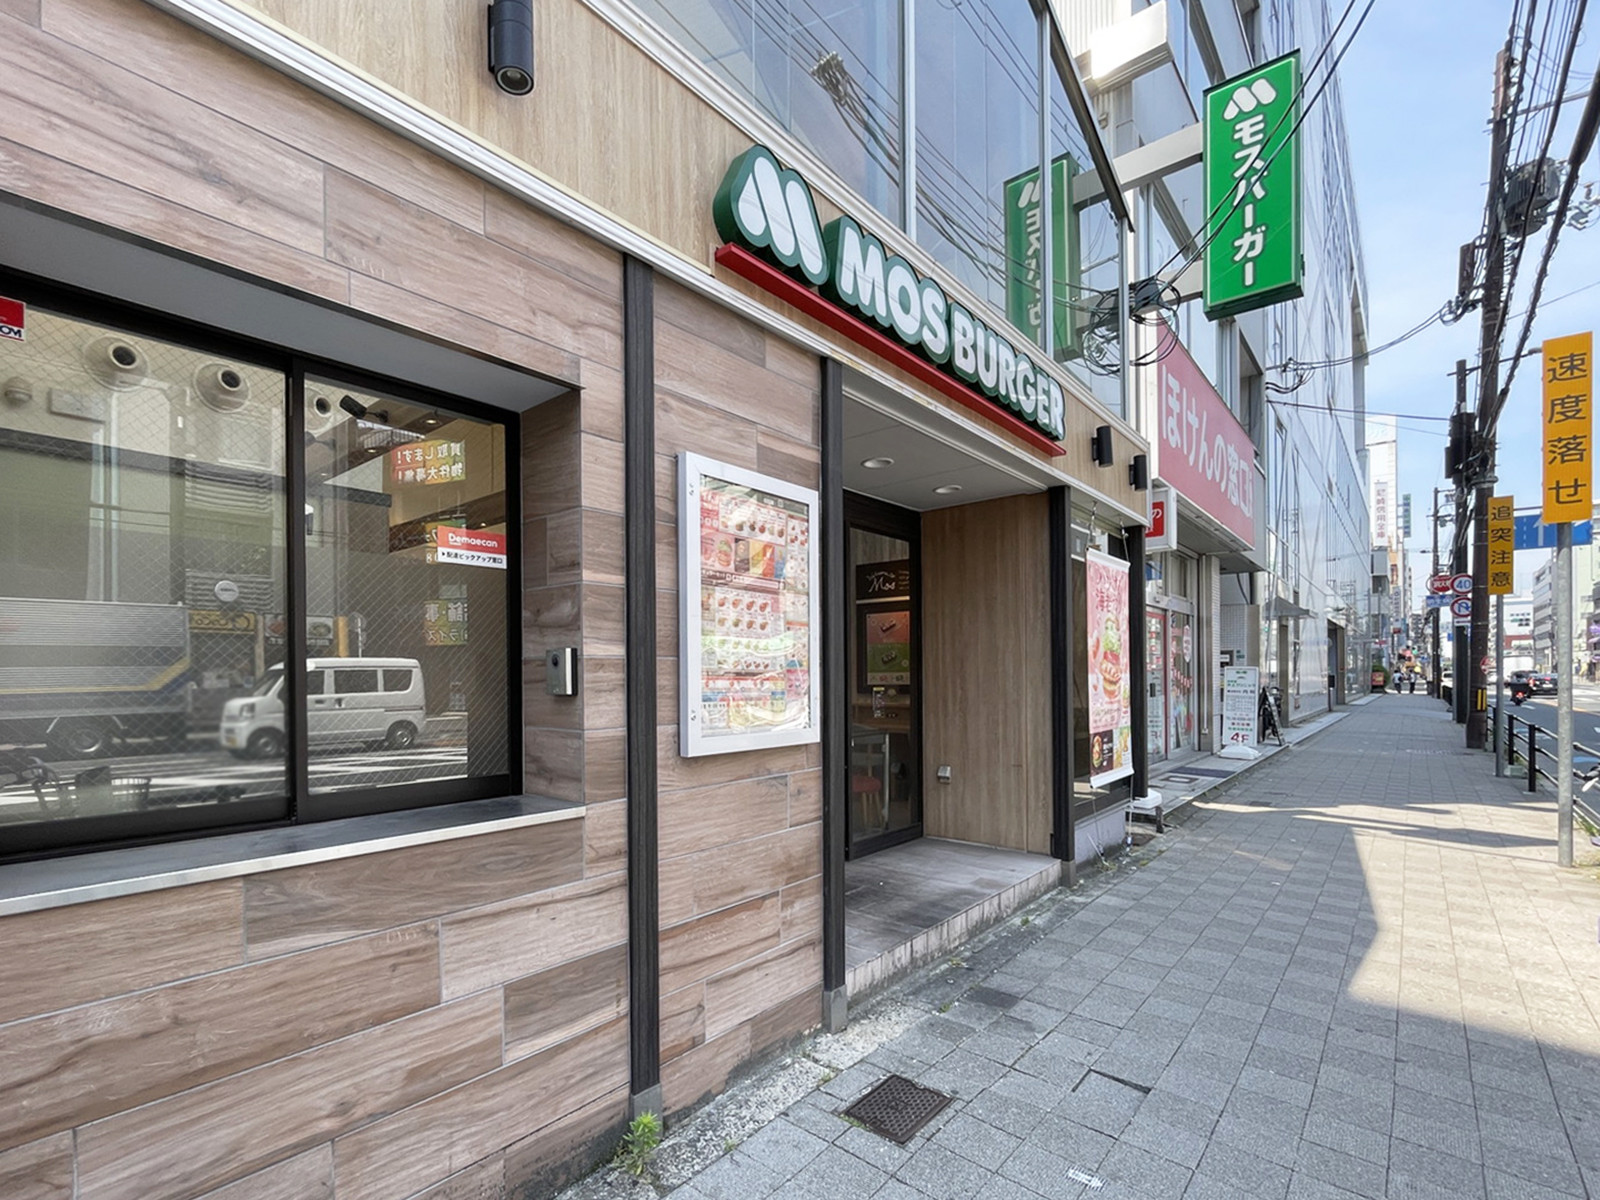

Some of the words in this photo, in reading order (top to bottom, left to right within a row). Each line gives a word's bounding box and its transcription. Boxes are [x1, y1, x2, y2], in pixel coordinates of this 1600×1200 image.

[1233, 114, 1267, 286] モスバーガー
[839, 226, 947, 356] MOS
[951, 308, 1065, 439] BURGER
[1162, 364, 1253, 518] ほけんの窓口
[1547, 352, 1588, 505] 速度落せ
[448, 532, 498, 548] Demaecan
[1456, 579, 1471, 590] 40
[1490, 505, 1511, 588] 追突注意
[1230, 732, 1250, 743] 4F
